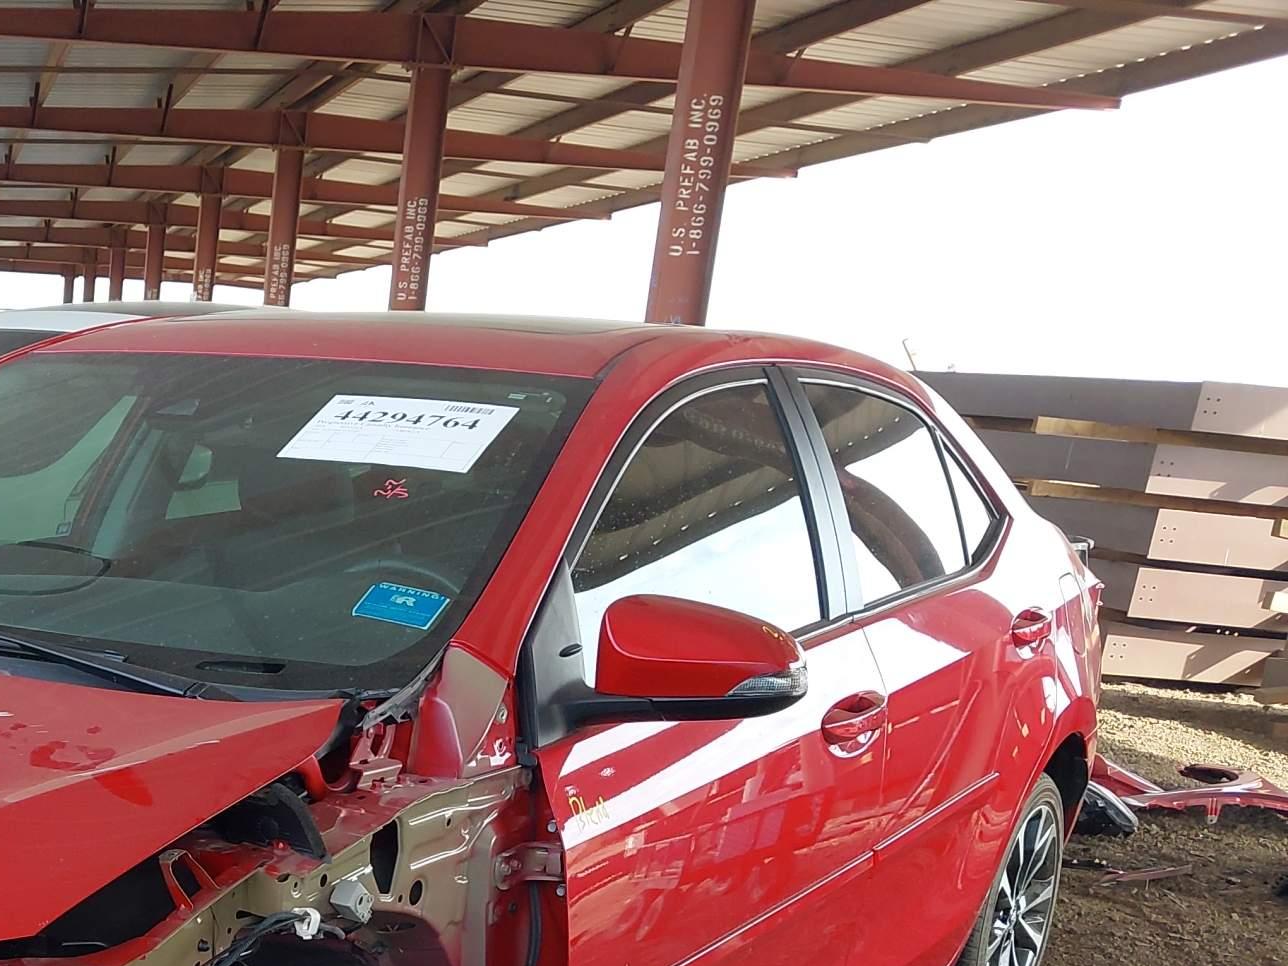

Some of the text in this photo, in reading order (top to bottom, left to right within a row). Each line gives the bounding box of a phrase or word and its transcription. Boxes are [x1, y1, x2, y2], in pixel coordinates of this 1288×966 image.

[676, 137, 700, 211] PREFAB
[688, 93, 707, 128] INC.
[686, 94, 724, 256] 1-866-799-0969
[400, 225, 415, 272] PREFAB
[334, 409, 481, 430] 44294764
